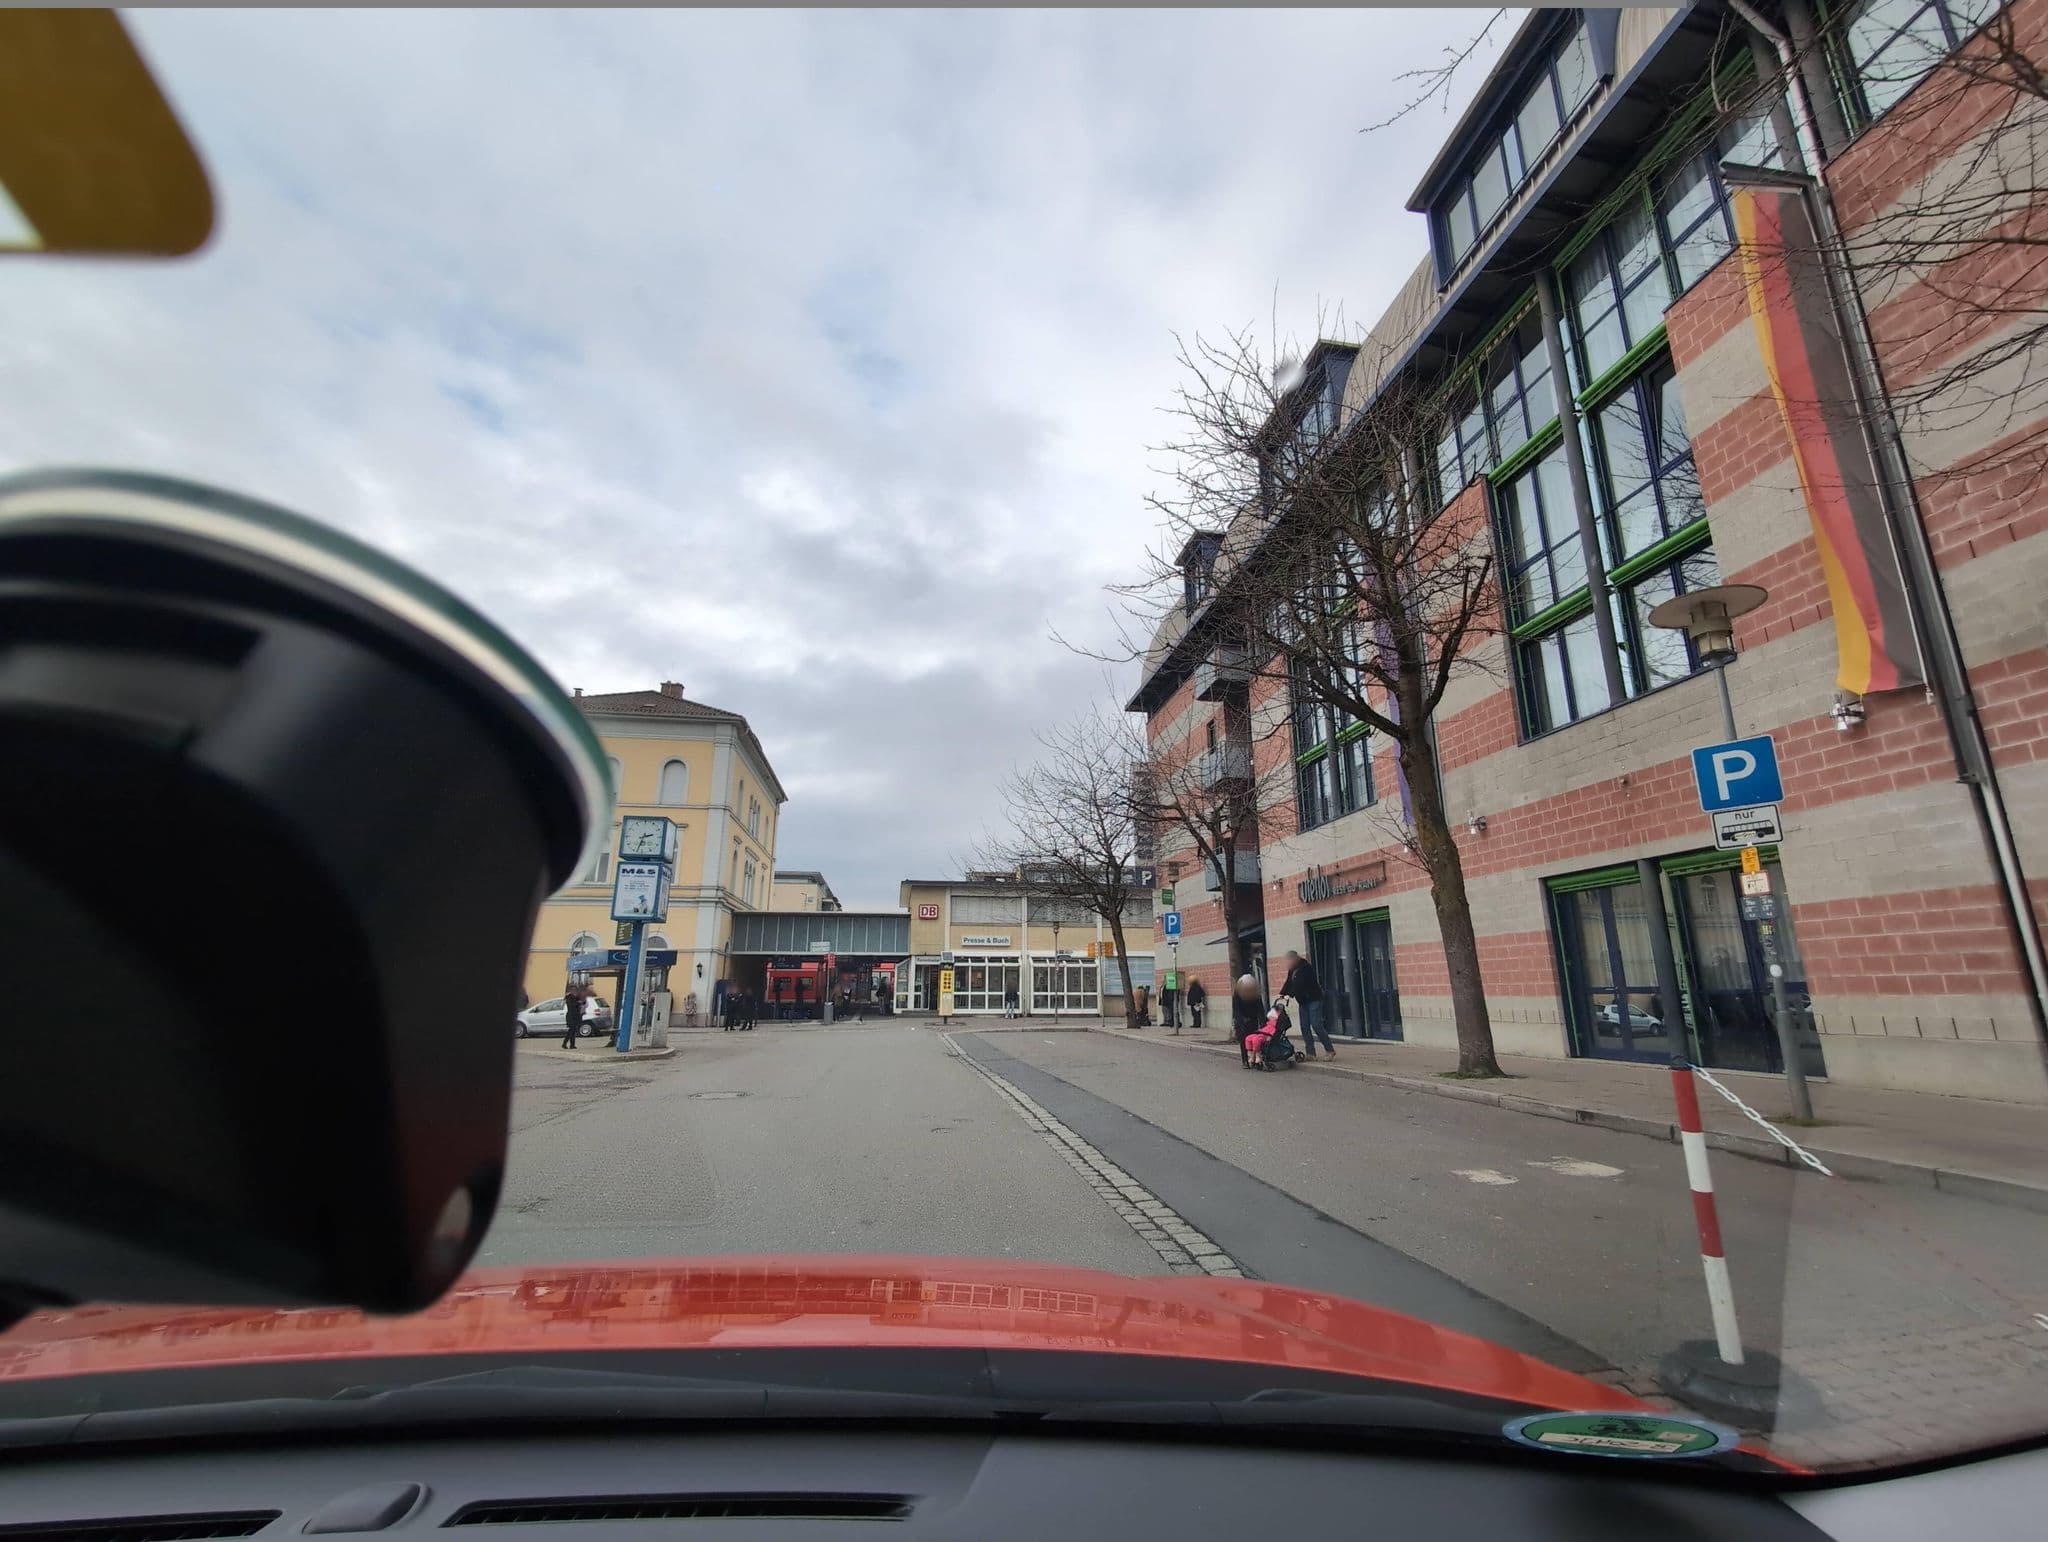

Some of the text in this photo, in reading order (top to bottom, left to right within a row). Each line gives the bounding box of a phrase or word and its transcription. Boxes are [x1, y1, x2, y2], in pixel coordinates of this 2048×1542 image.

[1712, 750, 1756, 800] P
[1734, 810, 1756, 821] nur
[1141, 870, 1153, 886] P
[921, 907, 936, 917] DB
[1167, 914, 1178, 933] P
